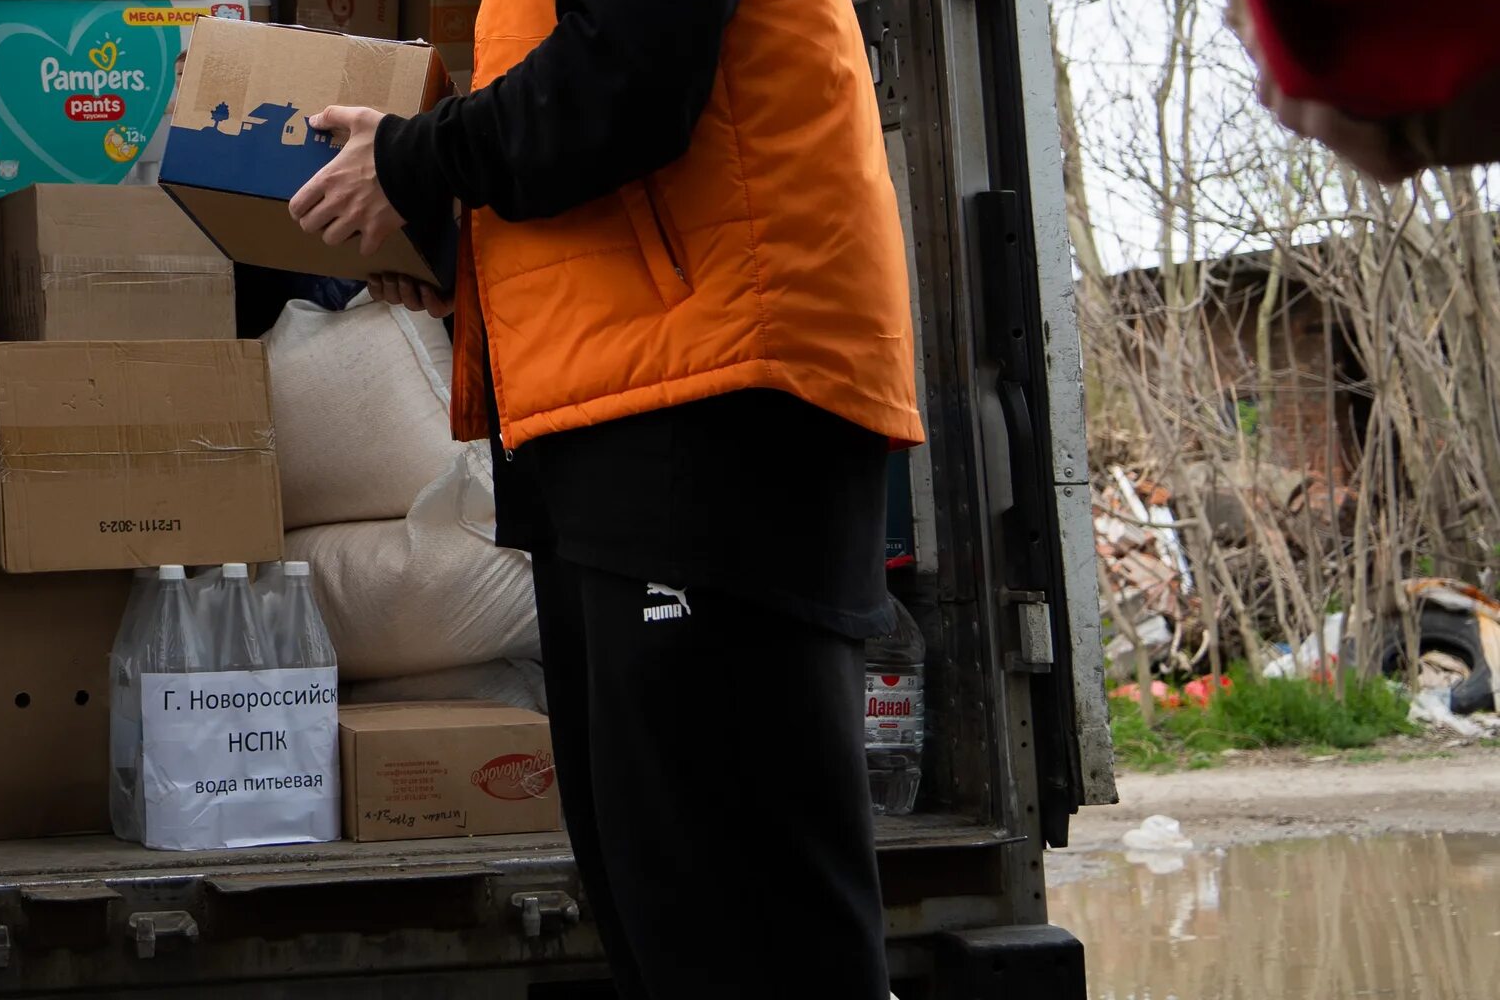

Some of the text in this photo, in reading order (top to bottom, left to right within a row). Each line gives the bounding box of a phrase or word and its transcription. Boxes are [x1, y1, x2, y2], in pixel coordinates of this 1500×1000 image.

[129, 12, 164, 22] MEGA
[40, 56, 145, 96] Pampers
[70, 96, 121, 116] pants
[99, 519, 181, 533] LF2111-302-3
[643, 603, 682, 622] PUMA
[163, 691, 182, 710] Г.
[866, 697, 911, 719] Данай
[229, 730, 288, 752] НСПК
[471, 750, 551, 785] РусМолоко
[195, 774, 323, 796] вода питьевая
